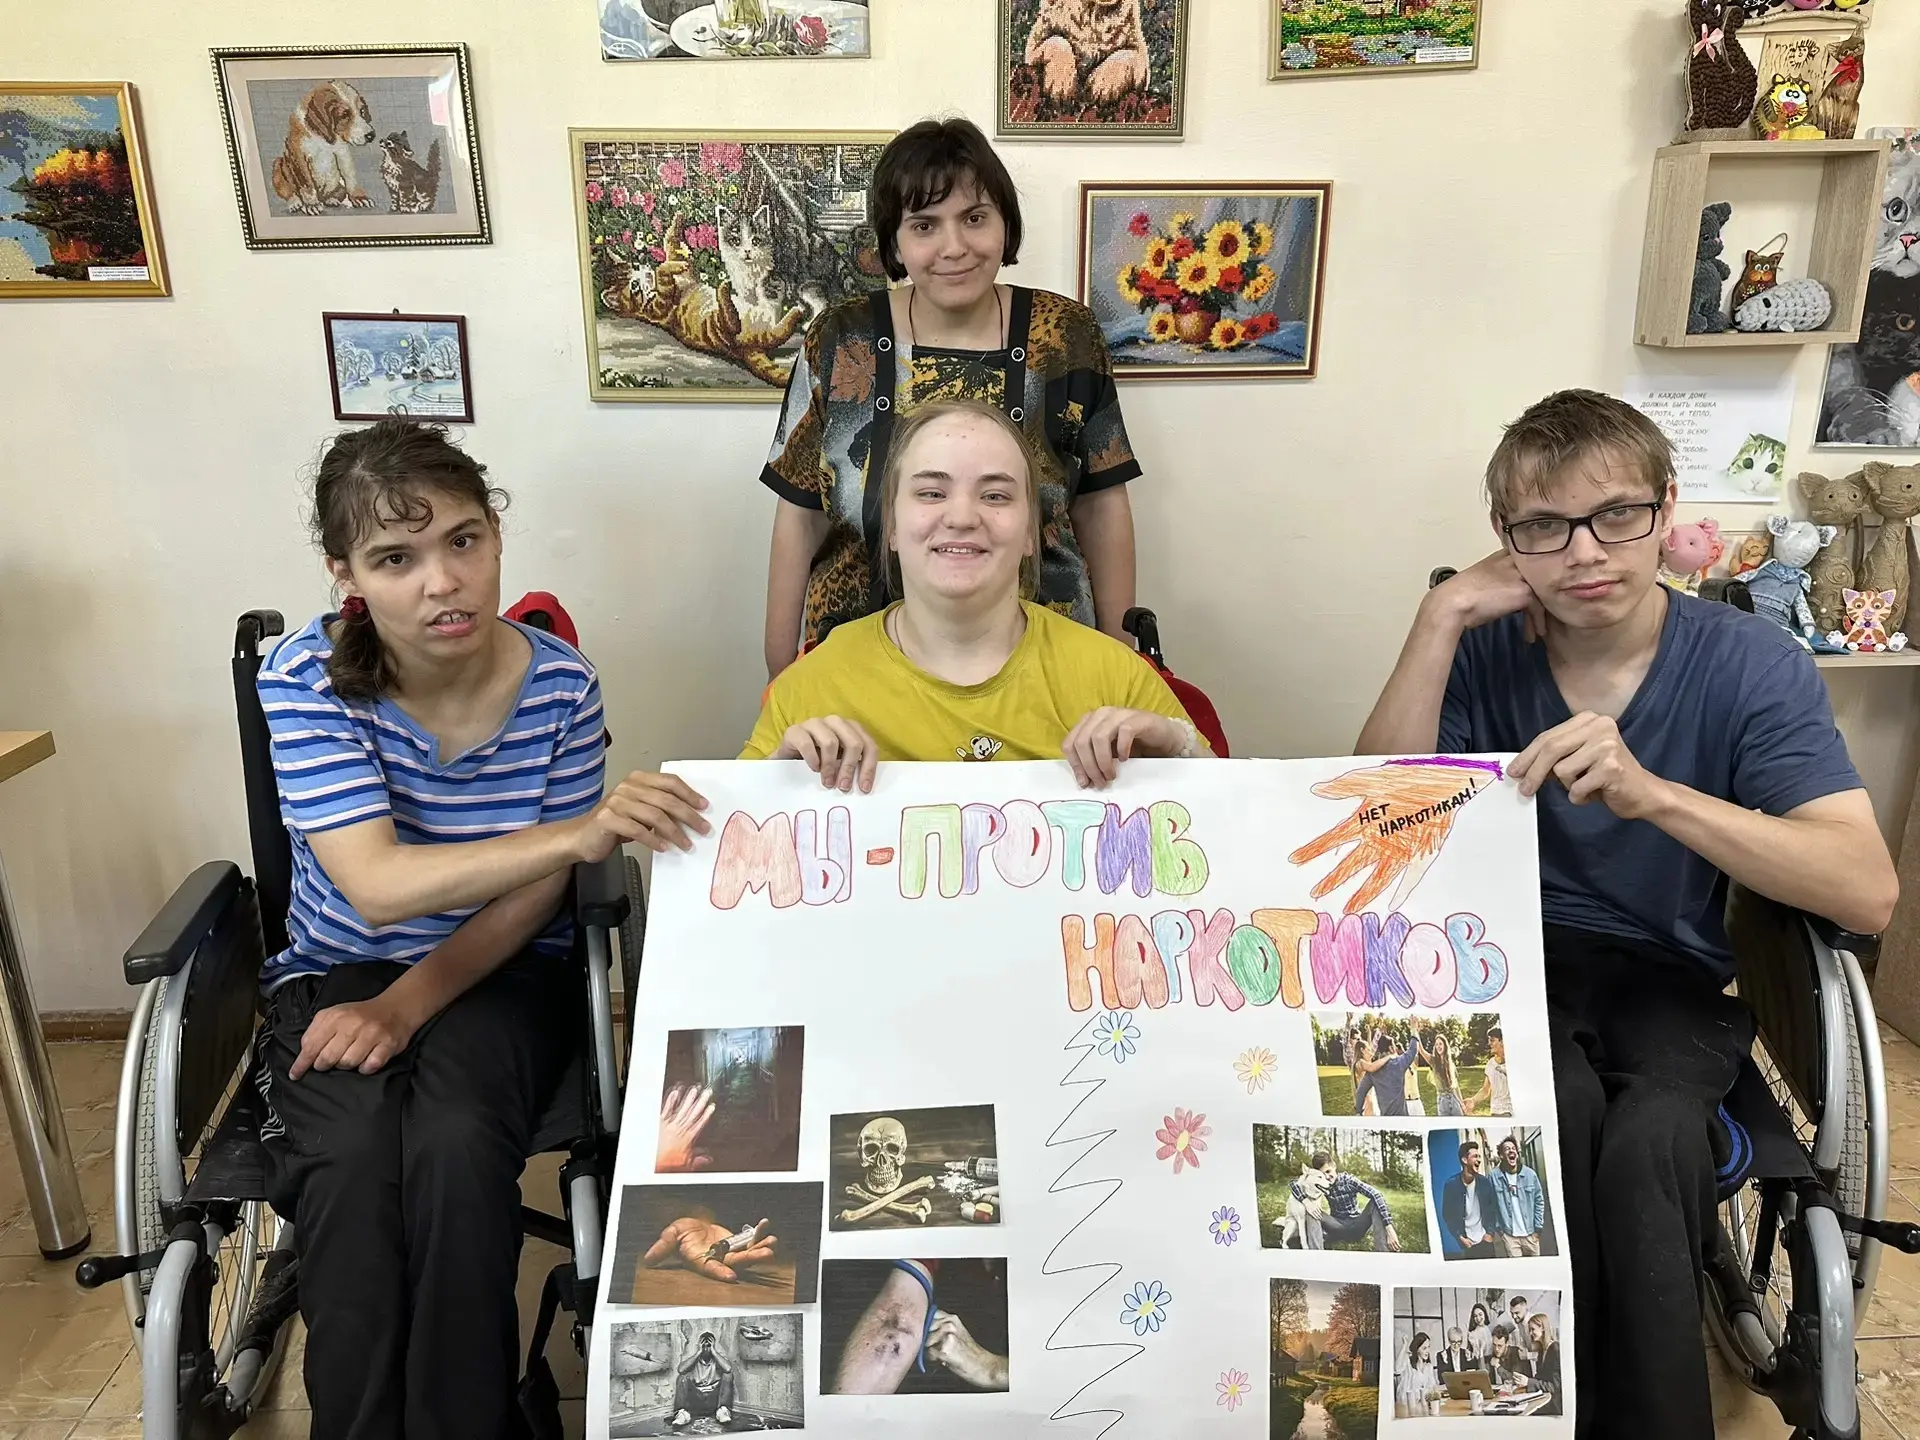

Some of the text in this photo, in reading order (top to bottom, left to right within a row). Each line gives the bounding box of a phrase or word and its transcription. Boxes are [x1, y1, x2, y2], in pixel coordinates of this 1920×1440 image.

[1640, 401, 1669, 409] ДОЛЖНА
[1672, 401, 1691, 409] БЫТЬ
[1648, 391, 1709, 400] В КАЖДОМ ДОМЕ
[1358, 803, 1390, 825] НЕТ
[1378, 777, 1477, 837] НАРКОТИКАМ!
[710, 804, 852, 910] МЫ
[898, 798, 1210, 900] ПРОТИВ
[1061, 907, 1509, 1012] НАРКОТИКОВ
